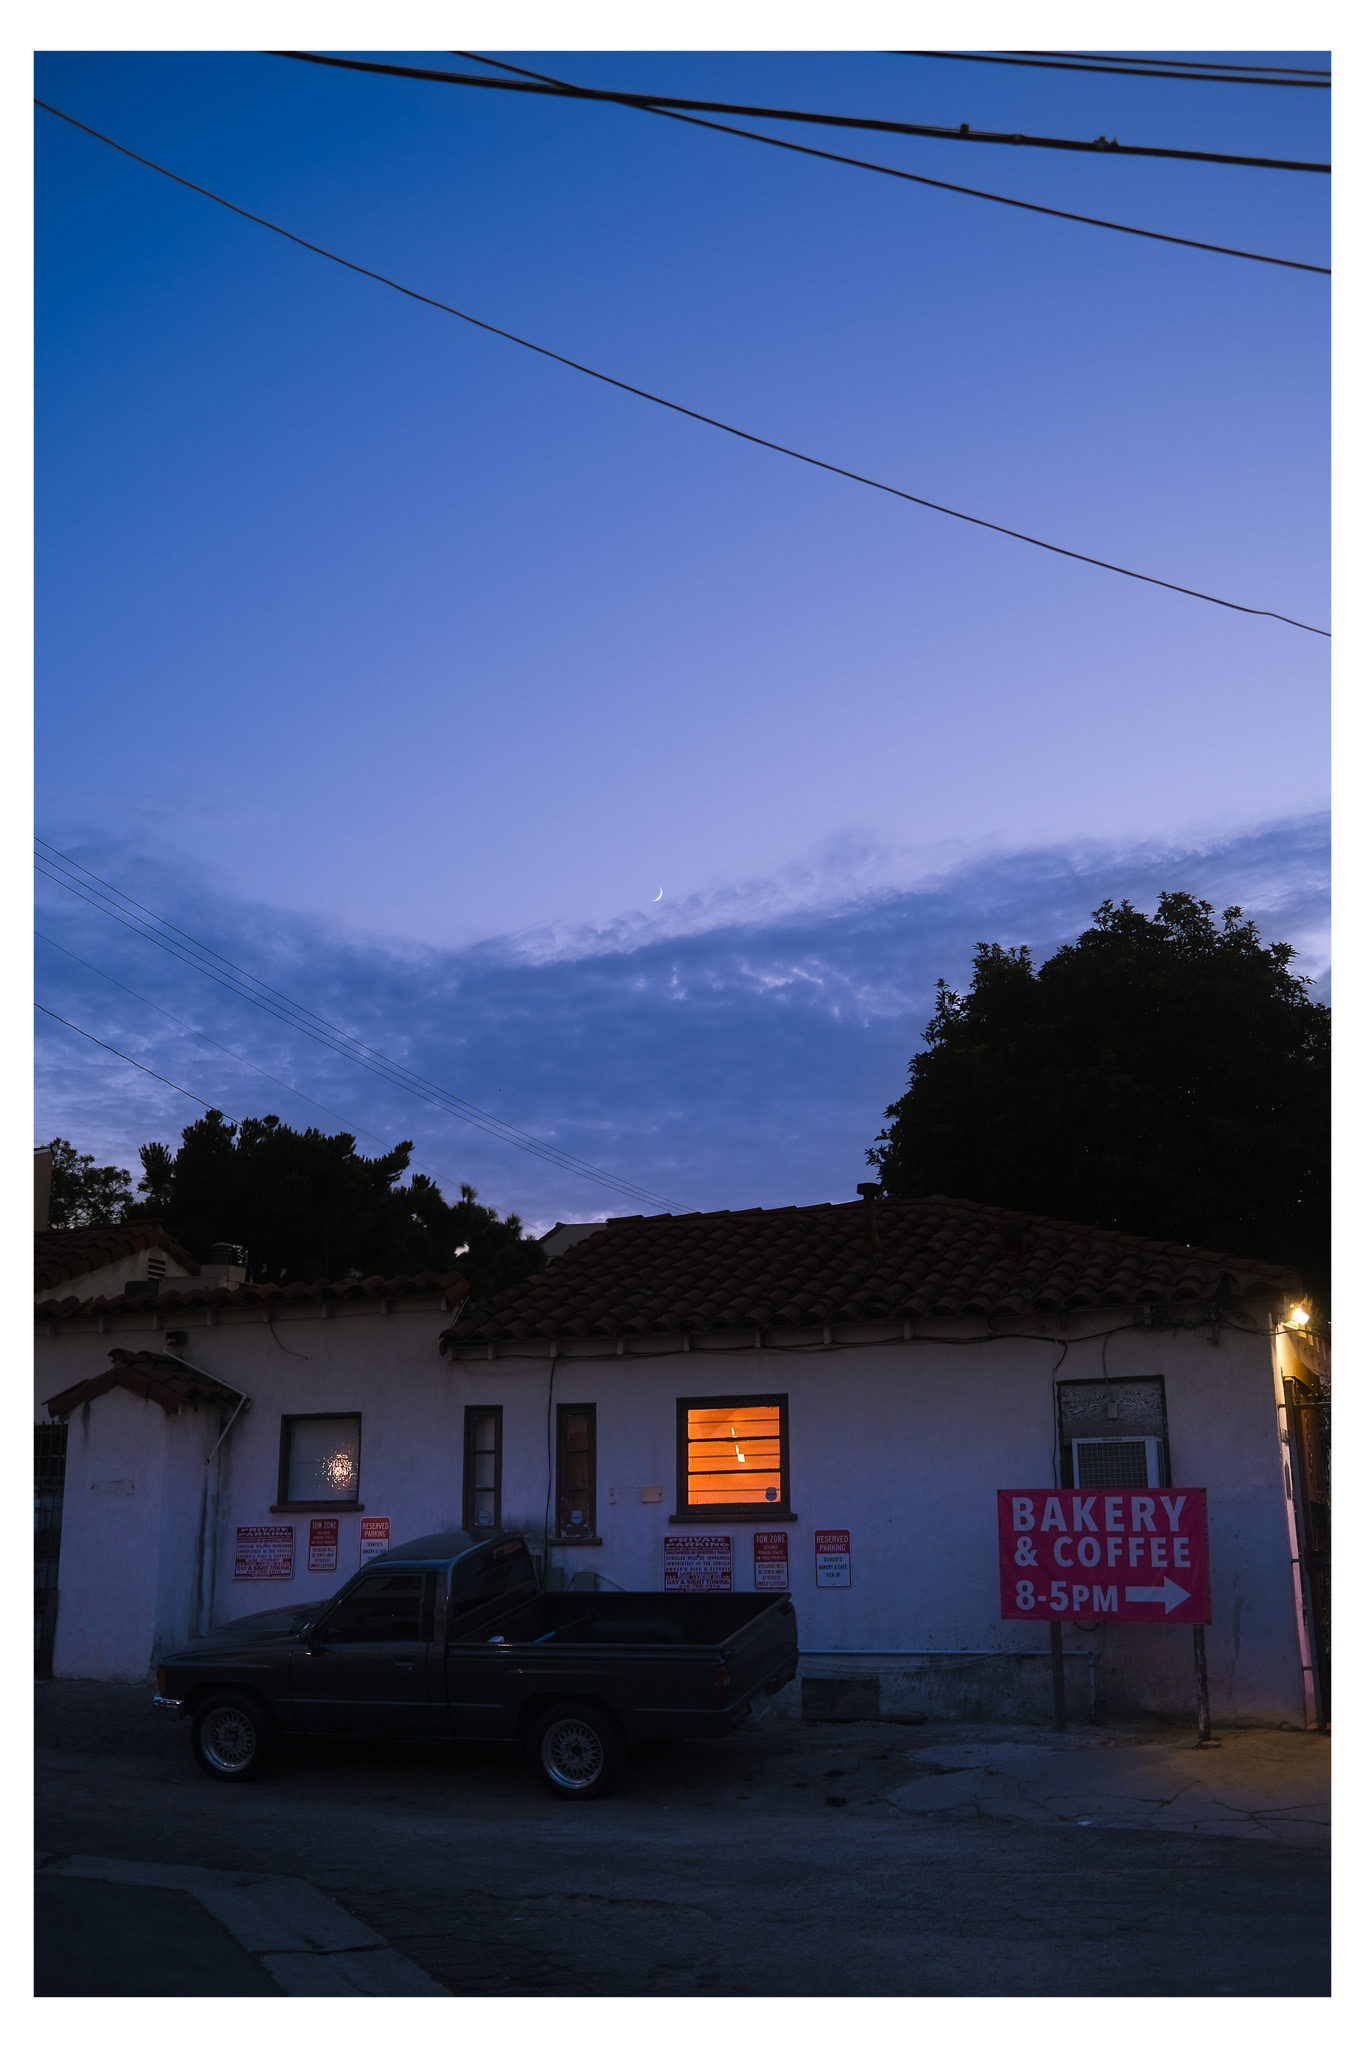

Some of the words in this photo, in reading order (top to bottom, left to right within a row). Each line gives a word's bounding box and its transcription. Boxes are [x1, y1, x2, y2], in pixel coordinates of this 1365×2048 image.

[1012, 1495, 1187, 1532] BAKERY
[312, 1521, 322, 1529] TOW
[323, 1521, 337, 1529] ZONE
[362, 1522, 389, 1530] RESERVED
[364, 1530, 386, 1538] PARKING
[756, 1535, 768, 1544] TOW
[769, 1534, 786, 1543] ZONE
[816, 1535, 849, 1543] RESERVED
[819, 1544, 846, 1552] PARKING
[1014, 1535, 1039, 1567] &
[1053, 1536, 1191, 1568] COFFEE
[1015, 1579, 1119, 1612] 8-5PM
